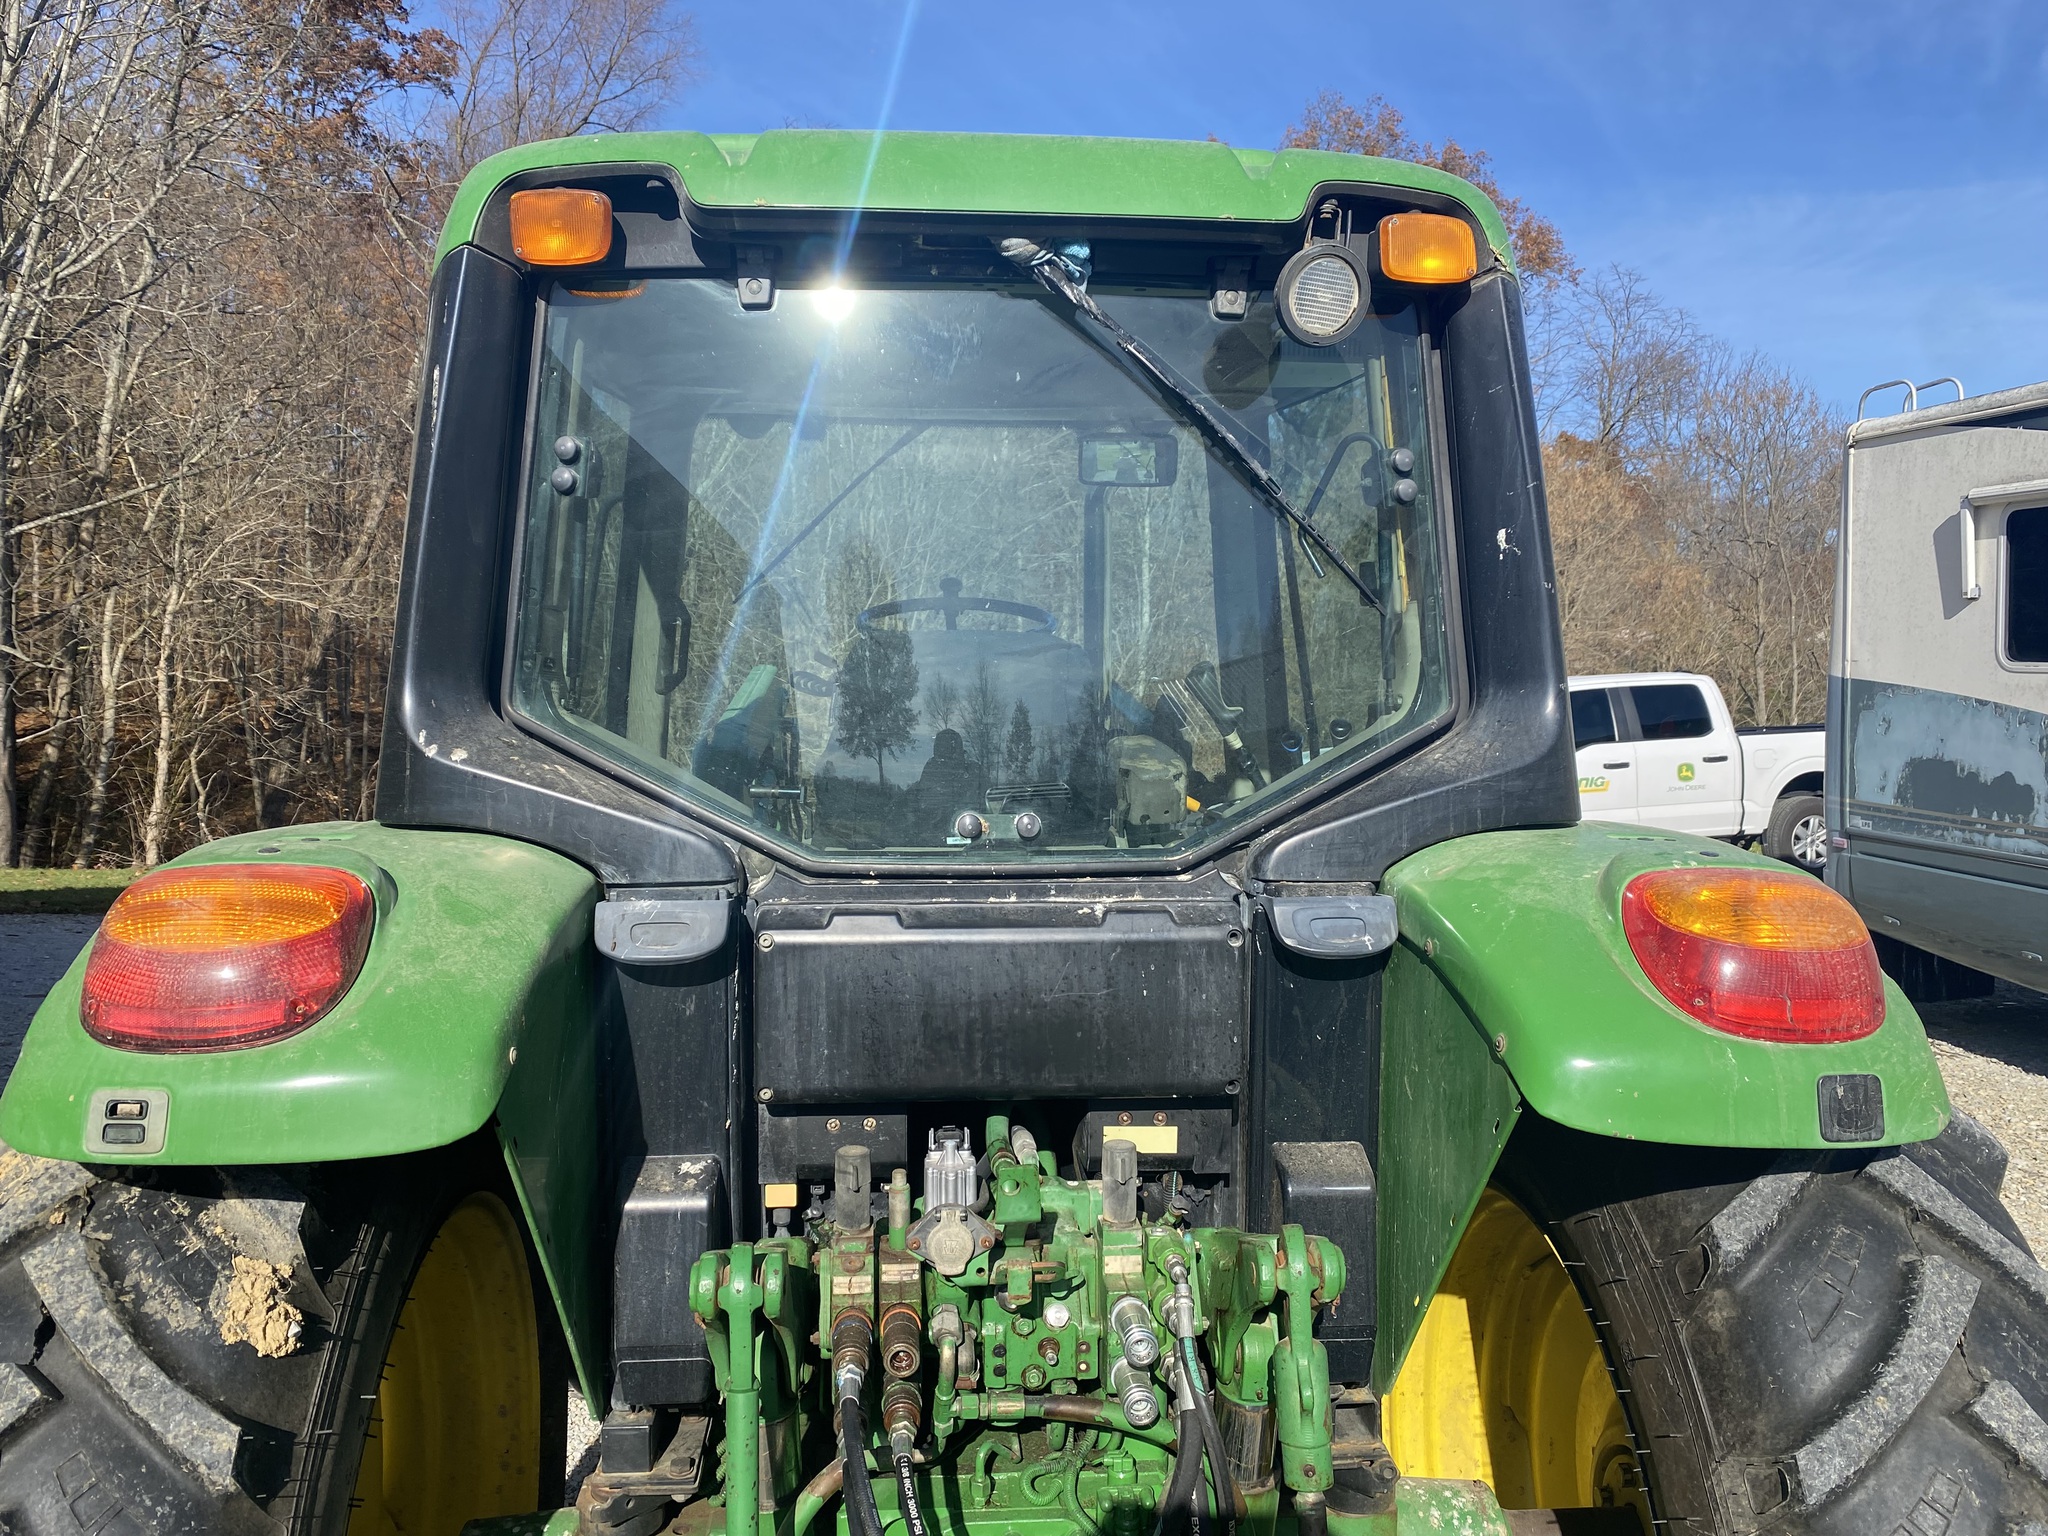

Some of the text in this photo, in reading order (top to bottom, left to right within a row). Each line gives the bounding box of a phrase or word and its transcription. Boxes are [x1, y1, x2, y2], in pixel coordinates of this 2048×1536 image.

[903, 1478, 914, 1498] INCH
[907, 1498, 918, 1519] 3000
[912, 1519, 923, 1535] PSI
